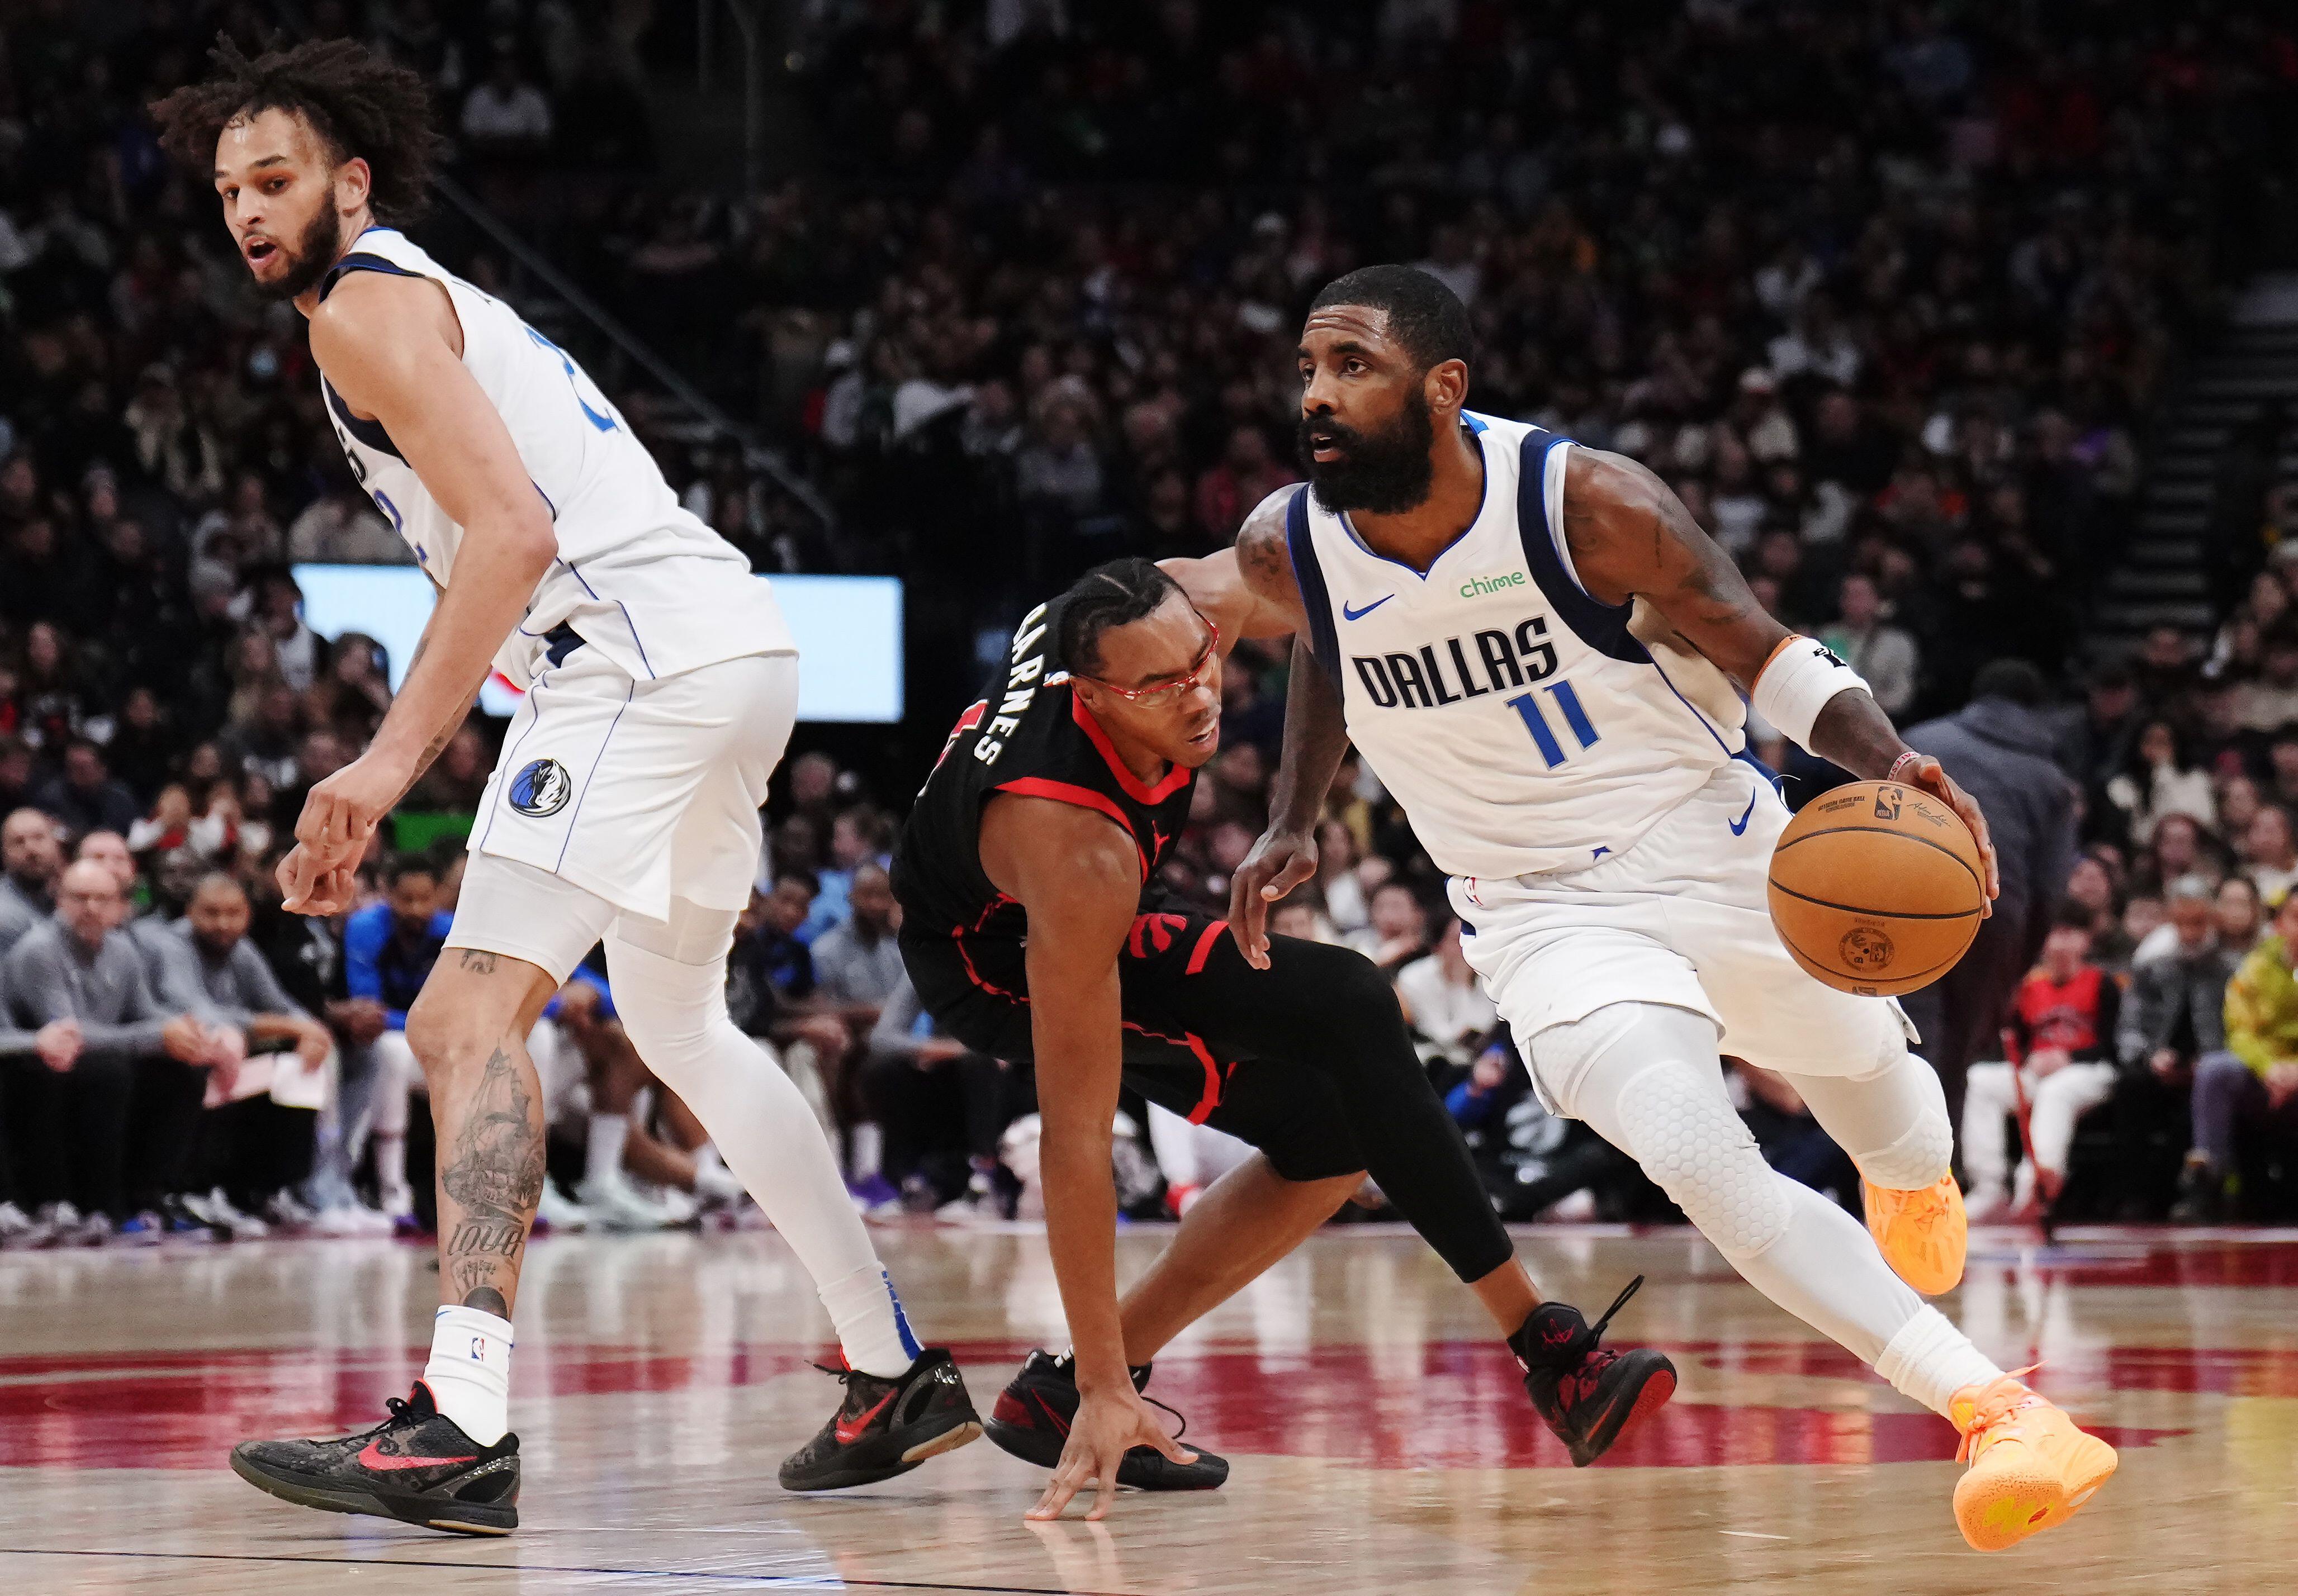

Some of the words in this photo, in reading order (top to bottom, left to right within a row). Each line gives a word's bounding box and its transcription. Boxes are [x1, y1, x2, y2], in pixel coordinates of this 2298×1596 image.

[1460, 571, 1525, 598] chime
[974, 602, 1047, 766] BARNES
[1350, 613, 1560, 710] DALLAS
[1503, 678, 1602, 771] 11
